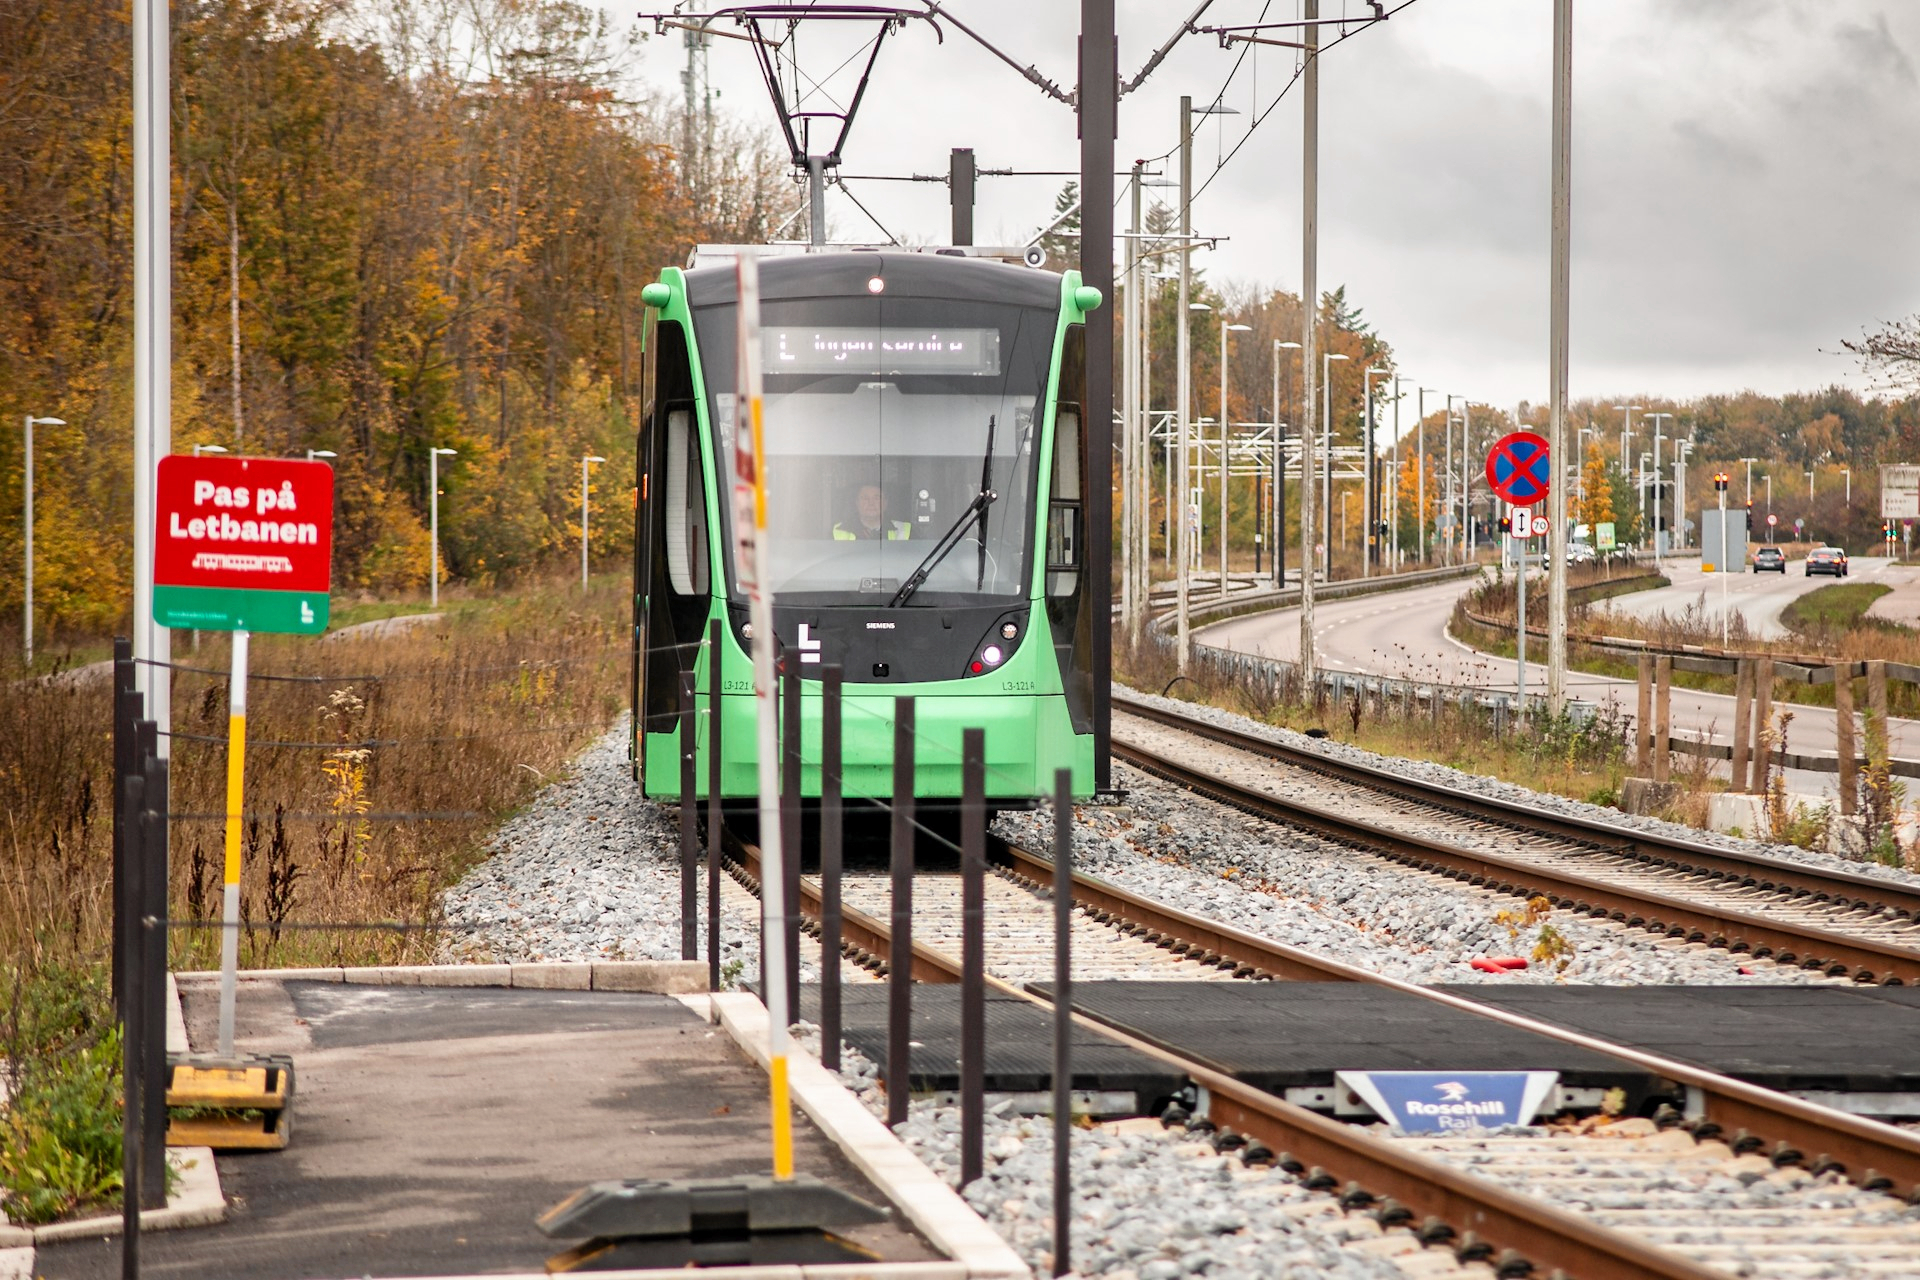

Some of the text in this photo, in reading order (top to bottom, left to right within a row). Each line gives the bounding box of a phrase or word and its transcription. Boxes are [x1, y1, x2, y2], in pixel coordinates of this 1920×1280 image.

[194, 480, 297, 515] Pas på
[170, 512, 318, 544] Letbanen
[1534, 521, 1546, 530] 70
[866, 622, 896, 630] SIEMENS
[723, 680, 749, 690] L3-121
[1002, 681, 1029, 691] L3-121
[1406, 1101, 1504, 1115] Rosehill
[1438, 1116, 1479, 1129] Rail
